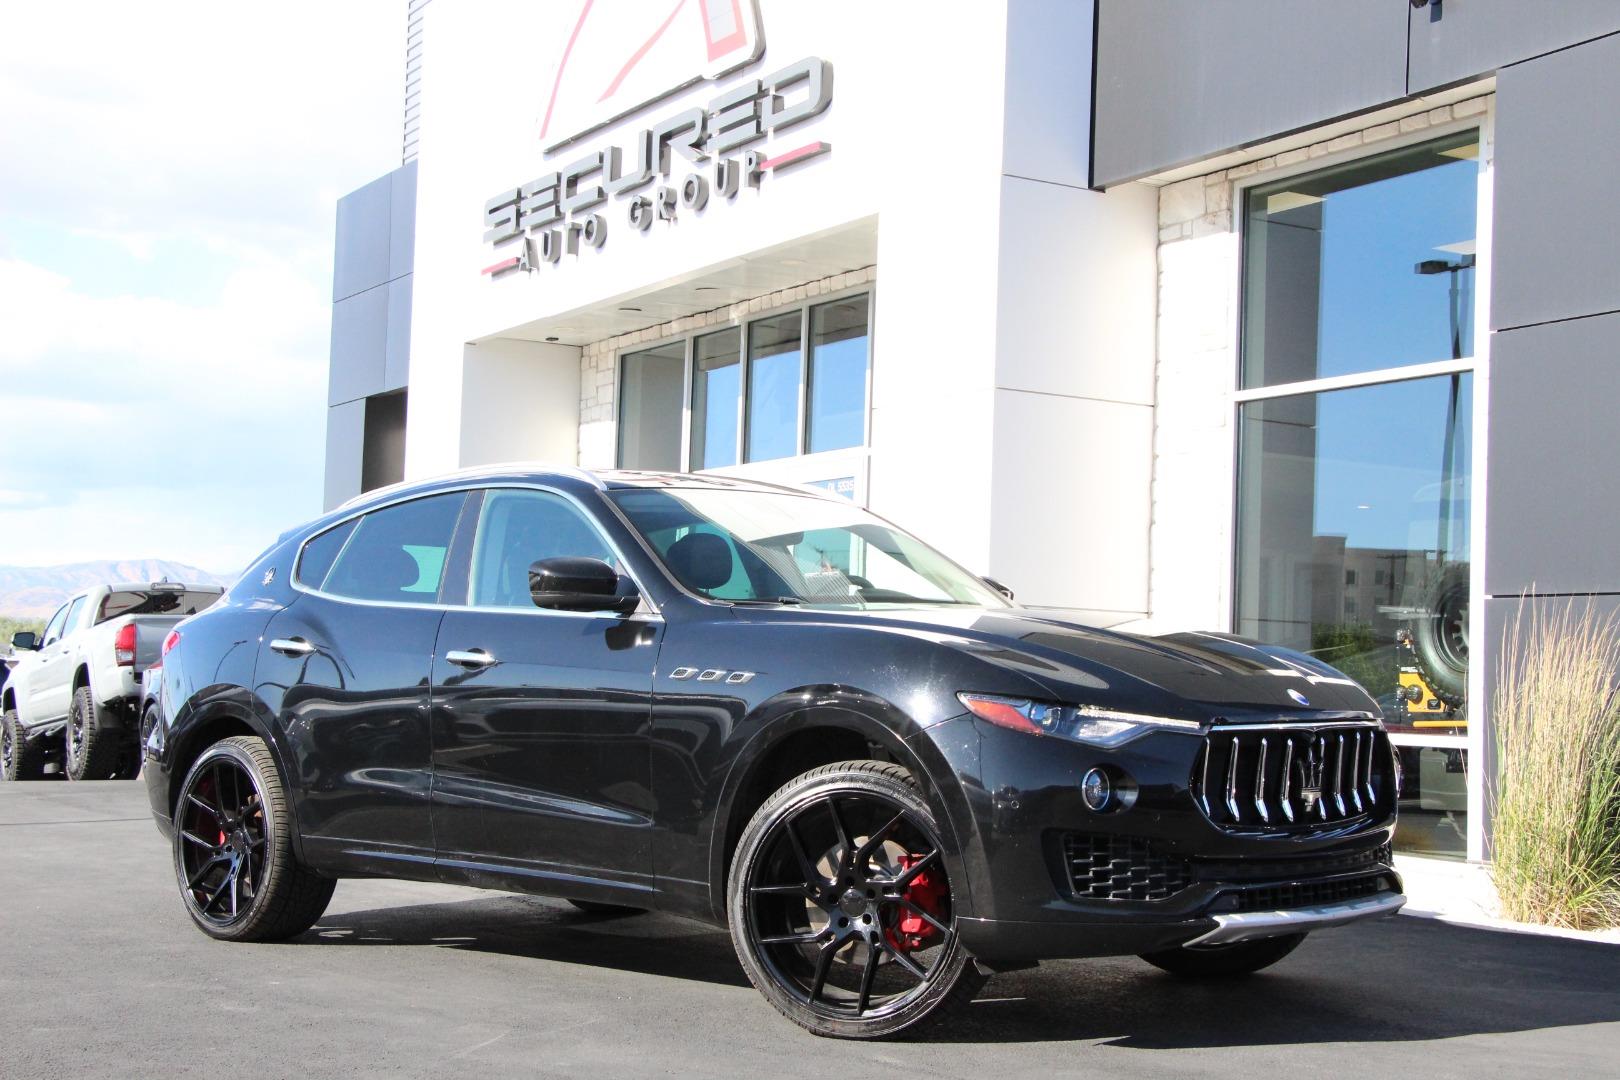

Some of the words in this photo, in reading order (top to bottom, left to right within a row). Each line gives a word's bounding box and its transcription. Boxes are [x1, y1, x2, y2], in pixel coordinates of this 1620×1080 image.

[483, 56, 834, 244] SECURED
[518, 213, 608, 274] AUTO
[627, 149, 768, 232] GROUP
